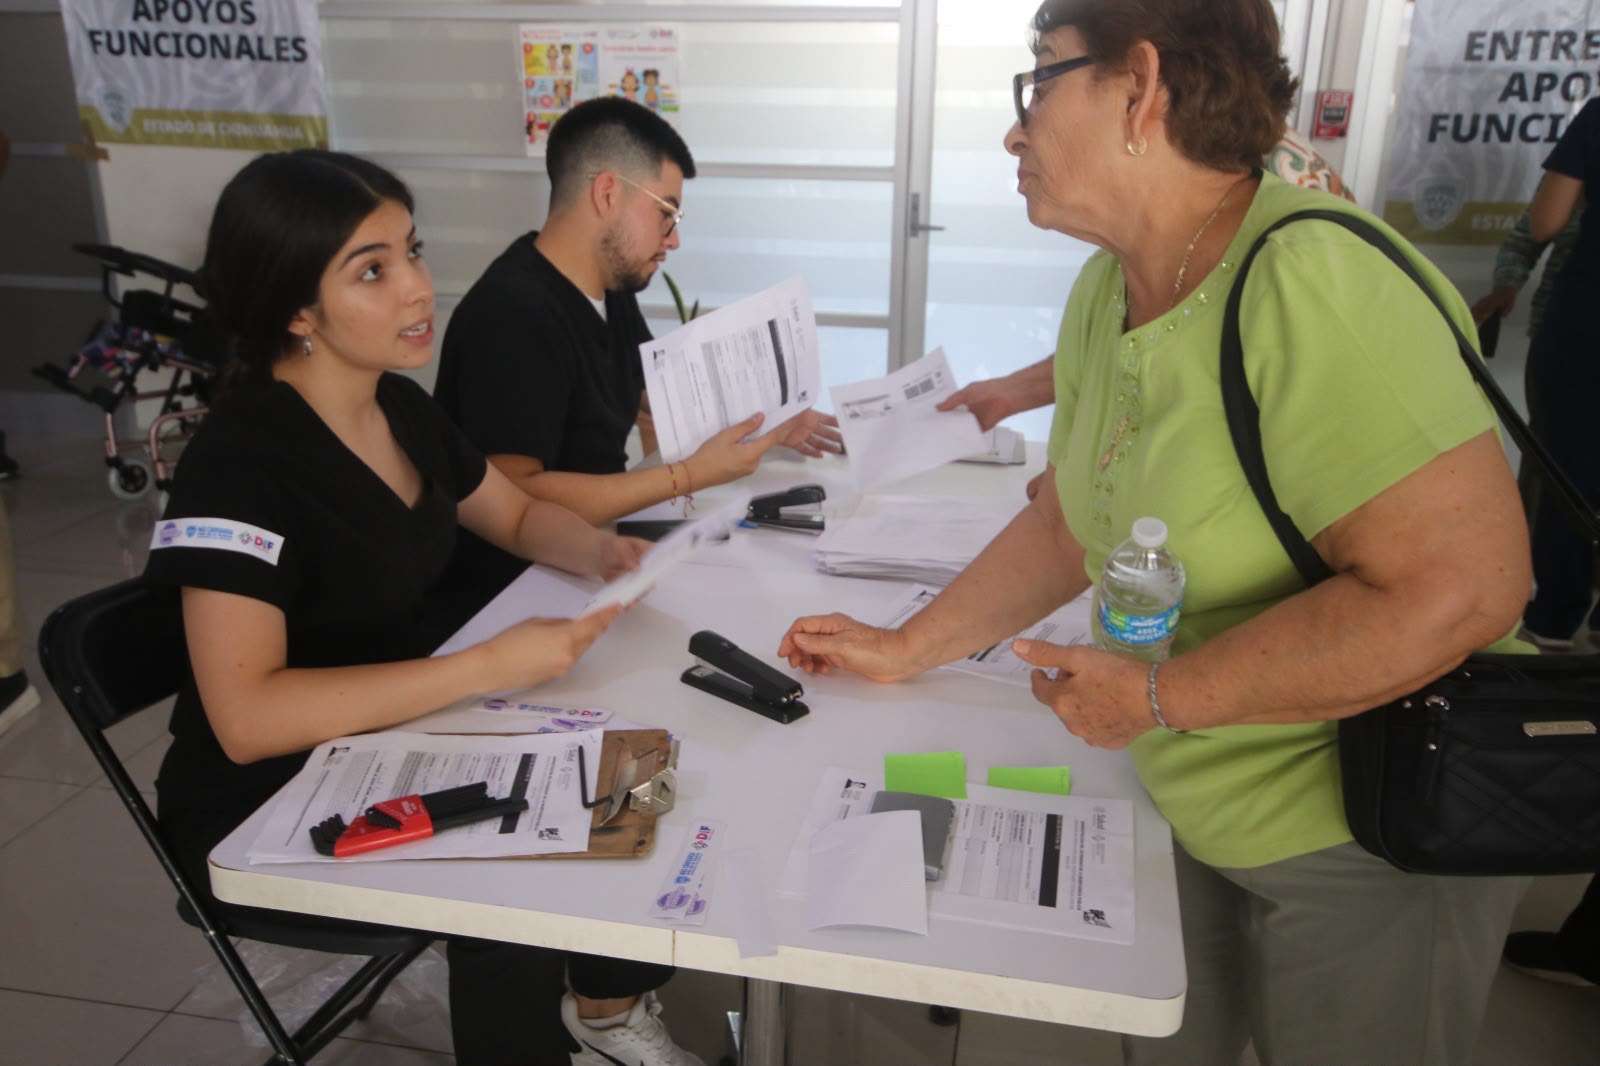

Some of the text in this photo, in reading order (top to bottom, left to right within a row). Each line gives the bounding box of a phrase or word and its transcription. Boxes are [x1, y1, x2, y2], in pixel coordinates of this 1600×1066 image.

[132, 0, 257, 26] APOYOS
[90, 29, 308, 63] FUNCIONALES
[1498, 71, 1600, 103] APO
[143, 118, 194, 135] ESTADO
